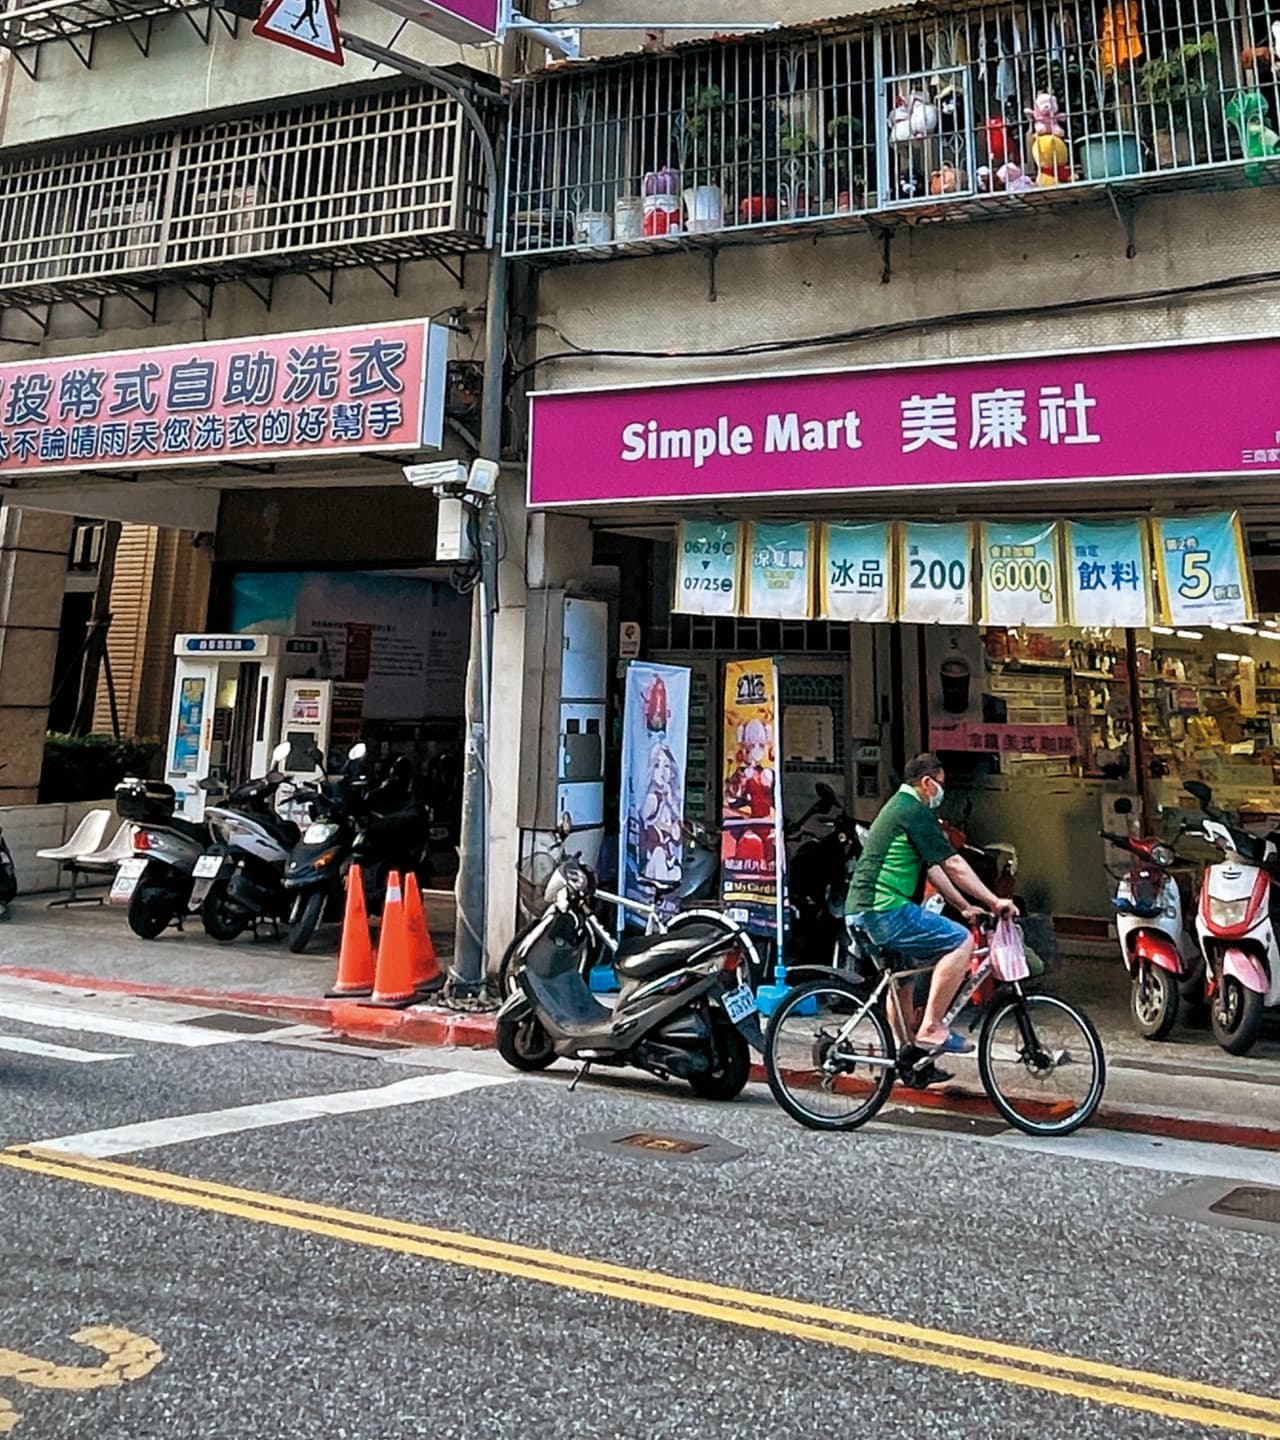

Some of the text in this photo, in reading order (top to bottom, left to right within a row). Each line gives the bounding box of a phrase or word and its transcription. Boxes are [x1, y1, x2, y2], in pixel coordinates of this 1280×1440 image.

[900, 383, 1101, 453] 美廉社
[621, 410, 863, 468] Simple Mart
[831, 560, 883, 588] 冰品
[909, 560, 966, 590] 200
[990, 560, 1052, 592] 6000
[1078, 560, 1139, 591] 飲料
[1179, 550, 1212, 600] 5
